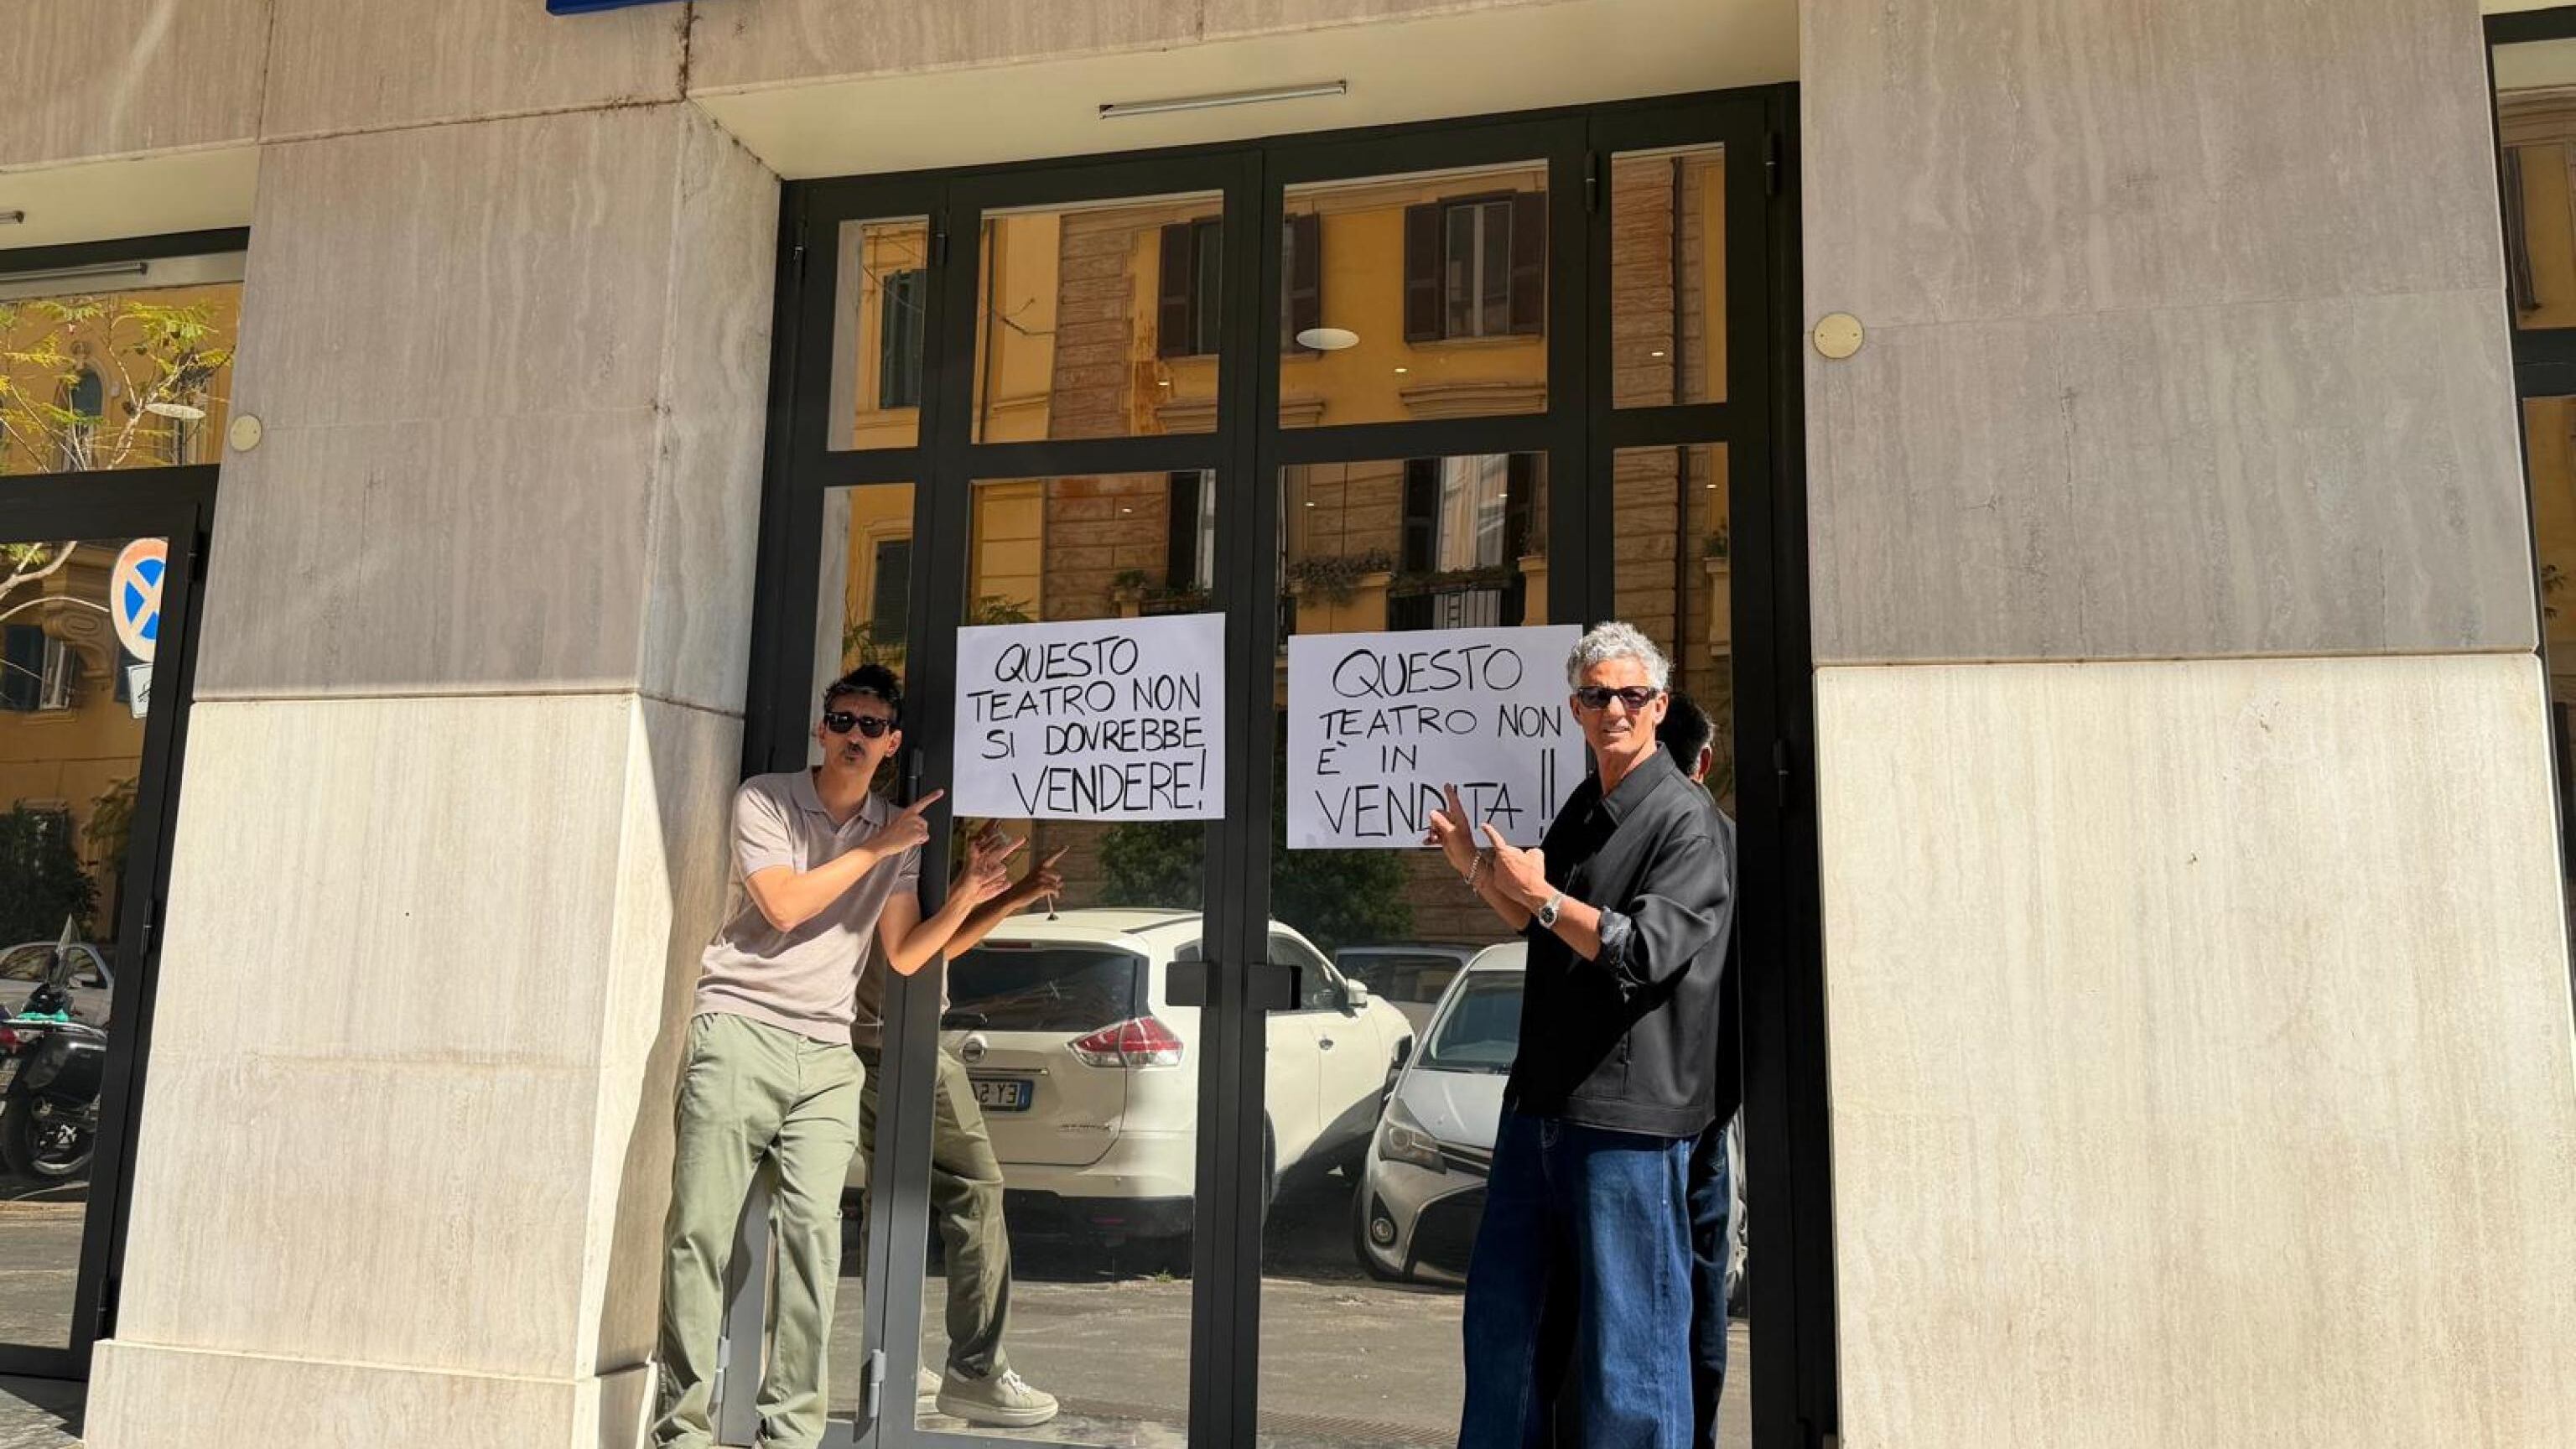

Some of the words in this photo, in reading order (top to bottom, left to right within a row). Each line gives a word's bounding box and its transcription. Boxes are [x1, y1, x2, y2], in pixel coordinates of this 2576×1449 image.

[995, 636, 1139, 683] QUESTO
[1332, 644, 1523, 699] QUESTO
[966, 680, 1115, 723] TEATRO
[1134, 672, 1201, 711] NON
[1319, 704, 1478, 740] TEATRO
[1498, 704, 1561, 738] NON
[981, 730, 1015, 759] SI
[1043, 717, 1207, 755] DOVREBBE
[1382, 745, 1417, 773] IN
[1012, 749, 1207, 816] VENDERE!
[1315, 782, 1524, 838] VENDTA
